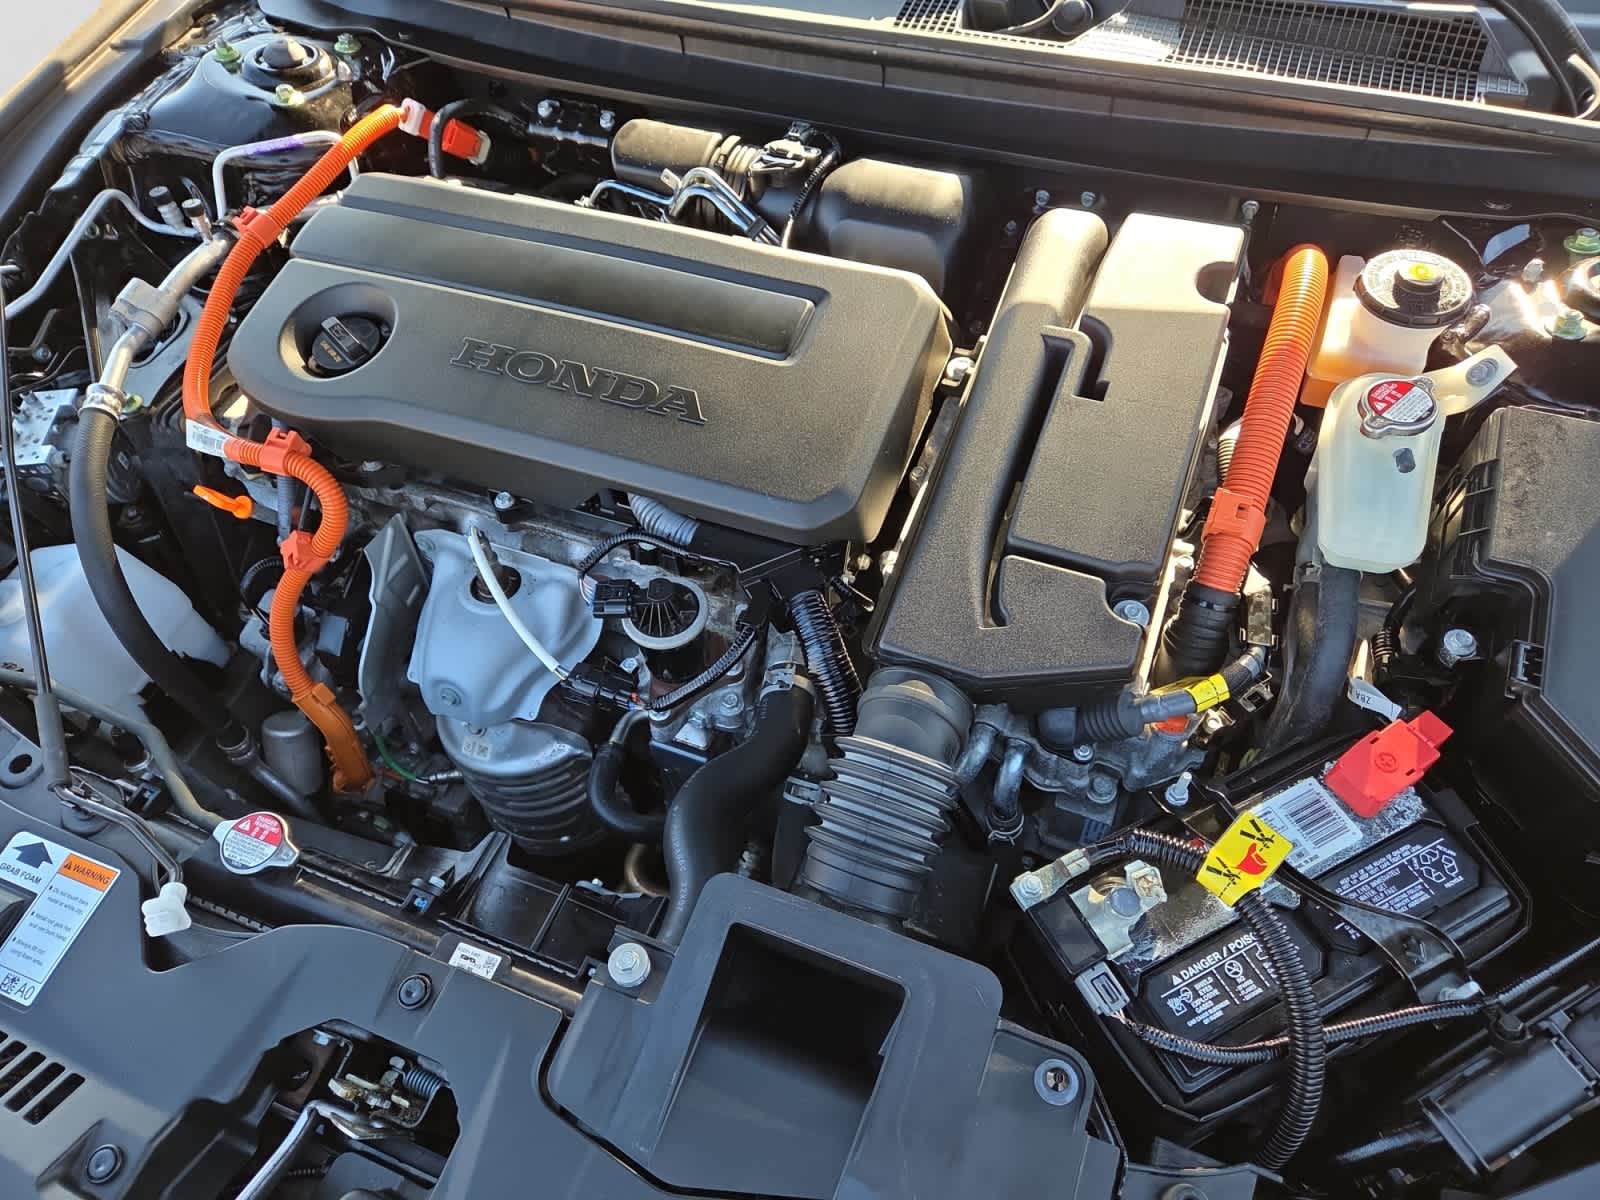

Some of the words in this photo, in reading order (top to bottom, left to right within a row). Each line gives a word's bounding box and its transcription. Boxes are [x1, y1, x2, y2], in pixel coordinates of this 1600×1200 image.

[449, 337, 708, 425] HONDA
[0, 862, 20, 876] GRAB
[21, 871, 43, 884] FOAM
[73, 863, 110, 885] WARNING
[1179, 952, 1222, 980] DANGER
